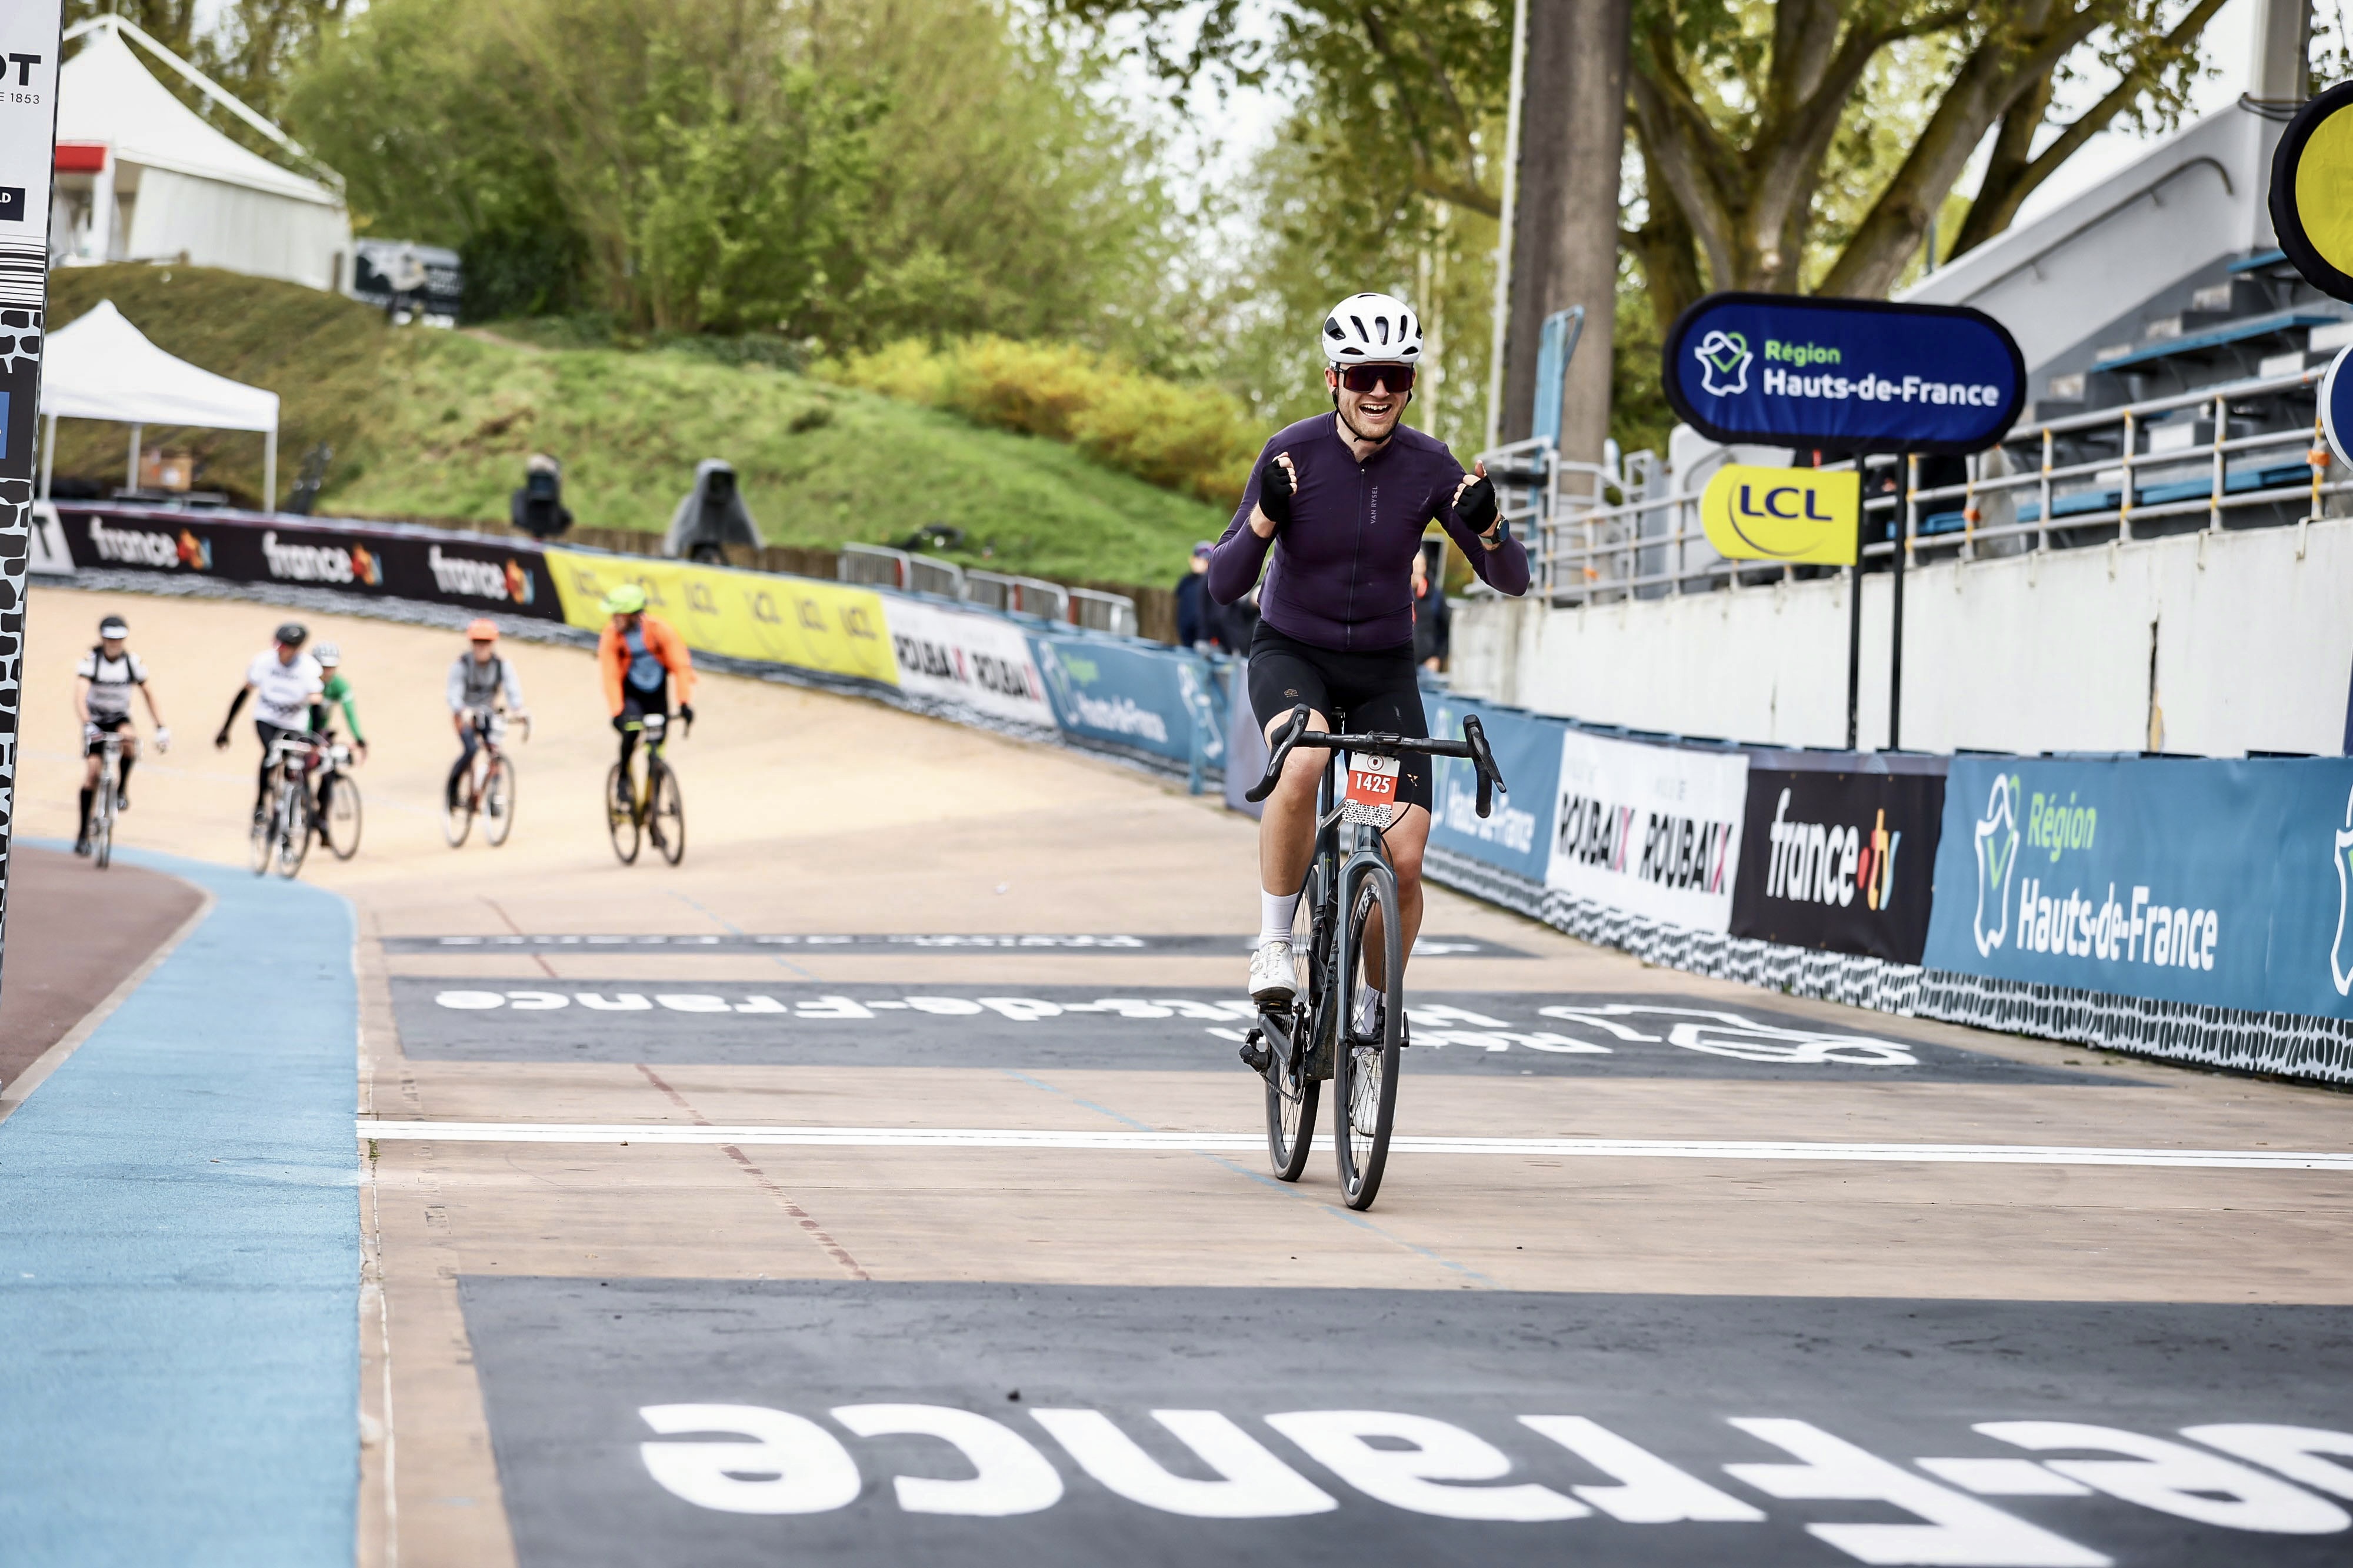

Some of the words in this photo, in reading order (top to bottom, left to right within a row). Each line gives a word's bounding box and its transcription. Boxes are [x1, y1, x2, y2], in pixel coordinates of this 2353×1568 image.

[0, 53, 41, 86] T
[11, 93, 39, 104] 1853
[1765, 339, 1841, 367] Région
[1764, 368, 2000, 407] Hauts-de-France
[1739, 485, 1833, 522] LCL
[1355, 773, 1391, 793] 1425
[1559, 792, 1635, 875] ROUBAIX
[1638, 812, 1733, 896] ROUBAIX
[2027, 791, 2097, 863] Région
[1765, 786, 1860, 908] france
[2016, 877, 2219, 972] Hauts-de-France
